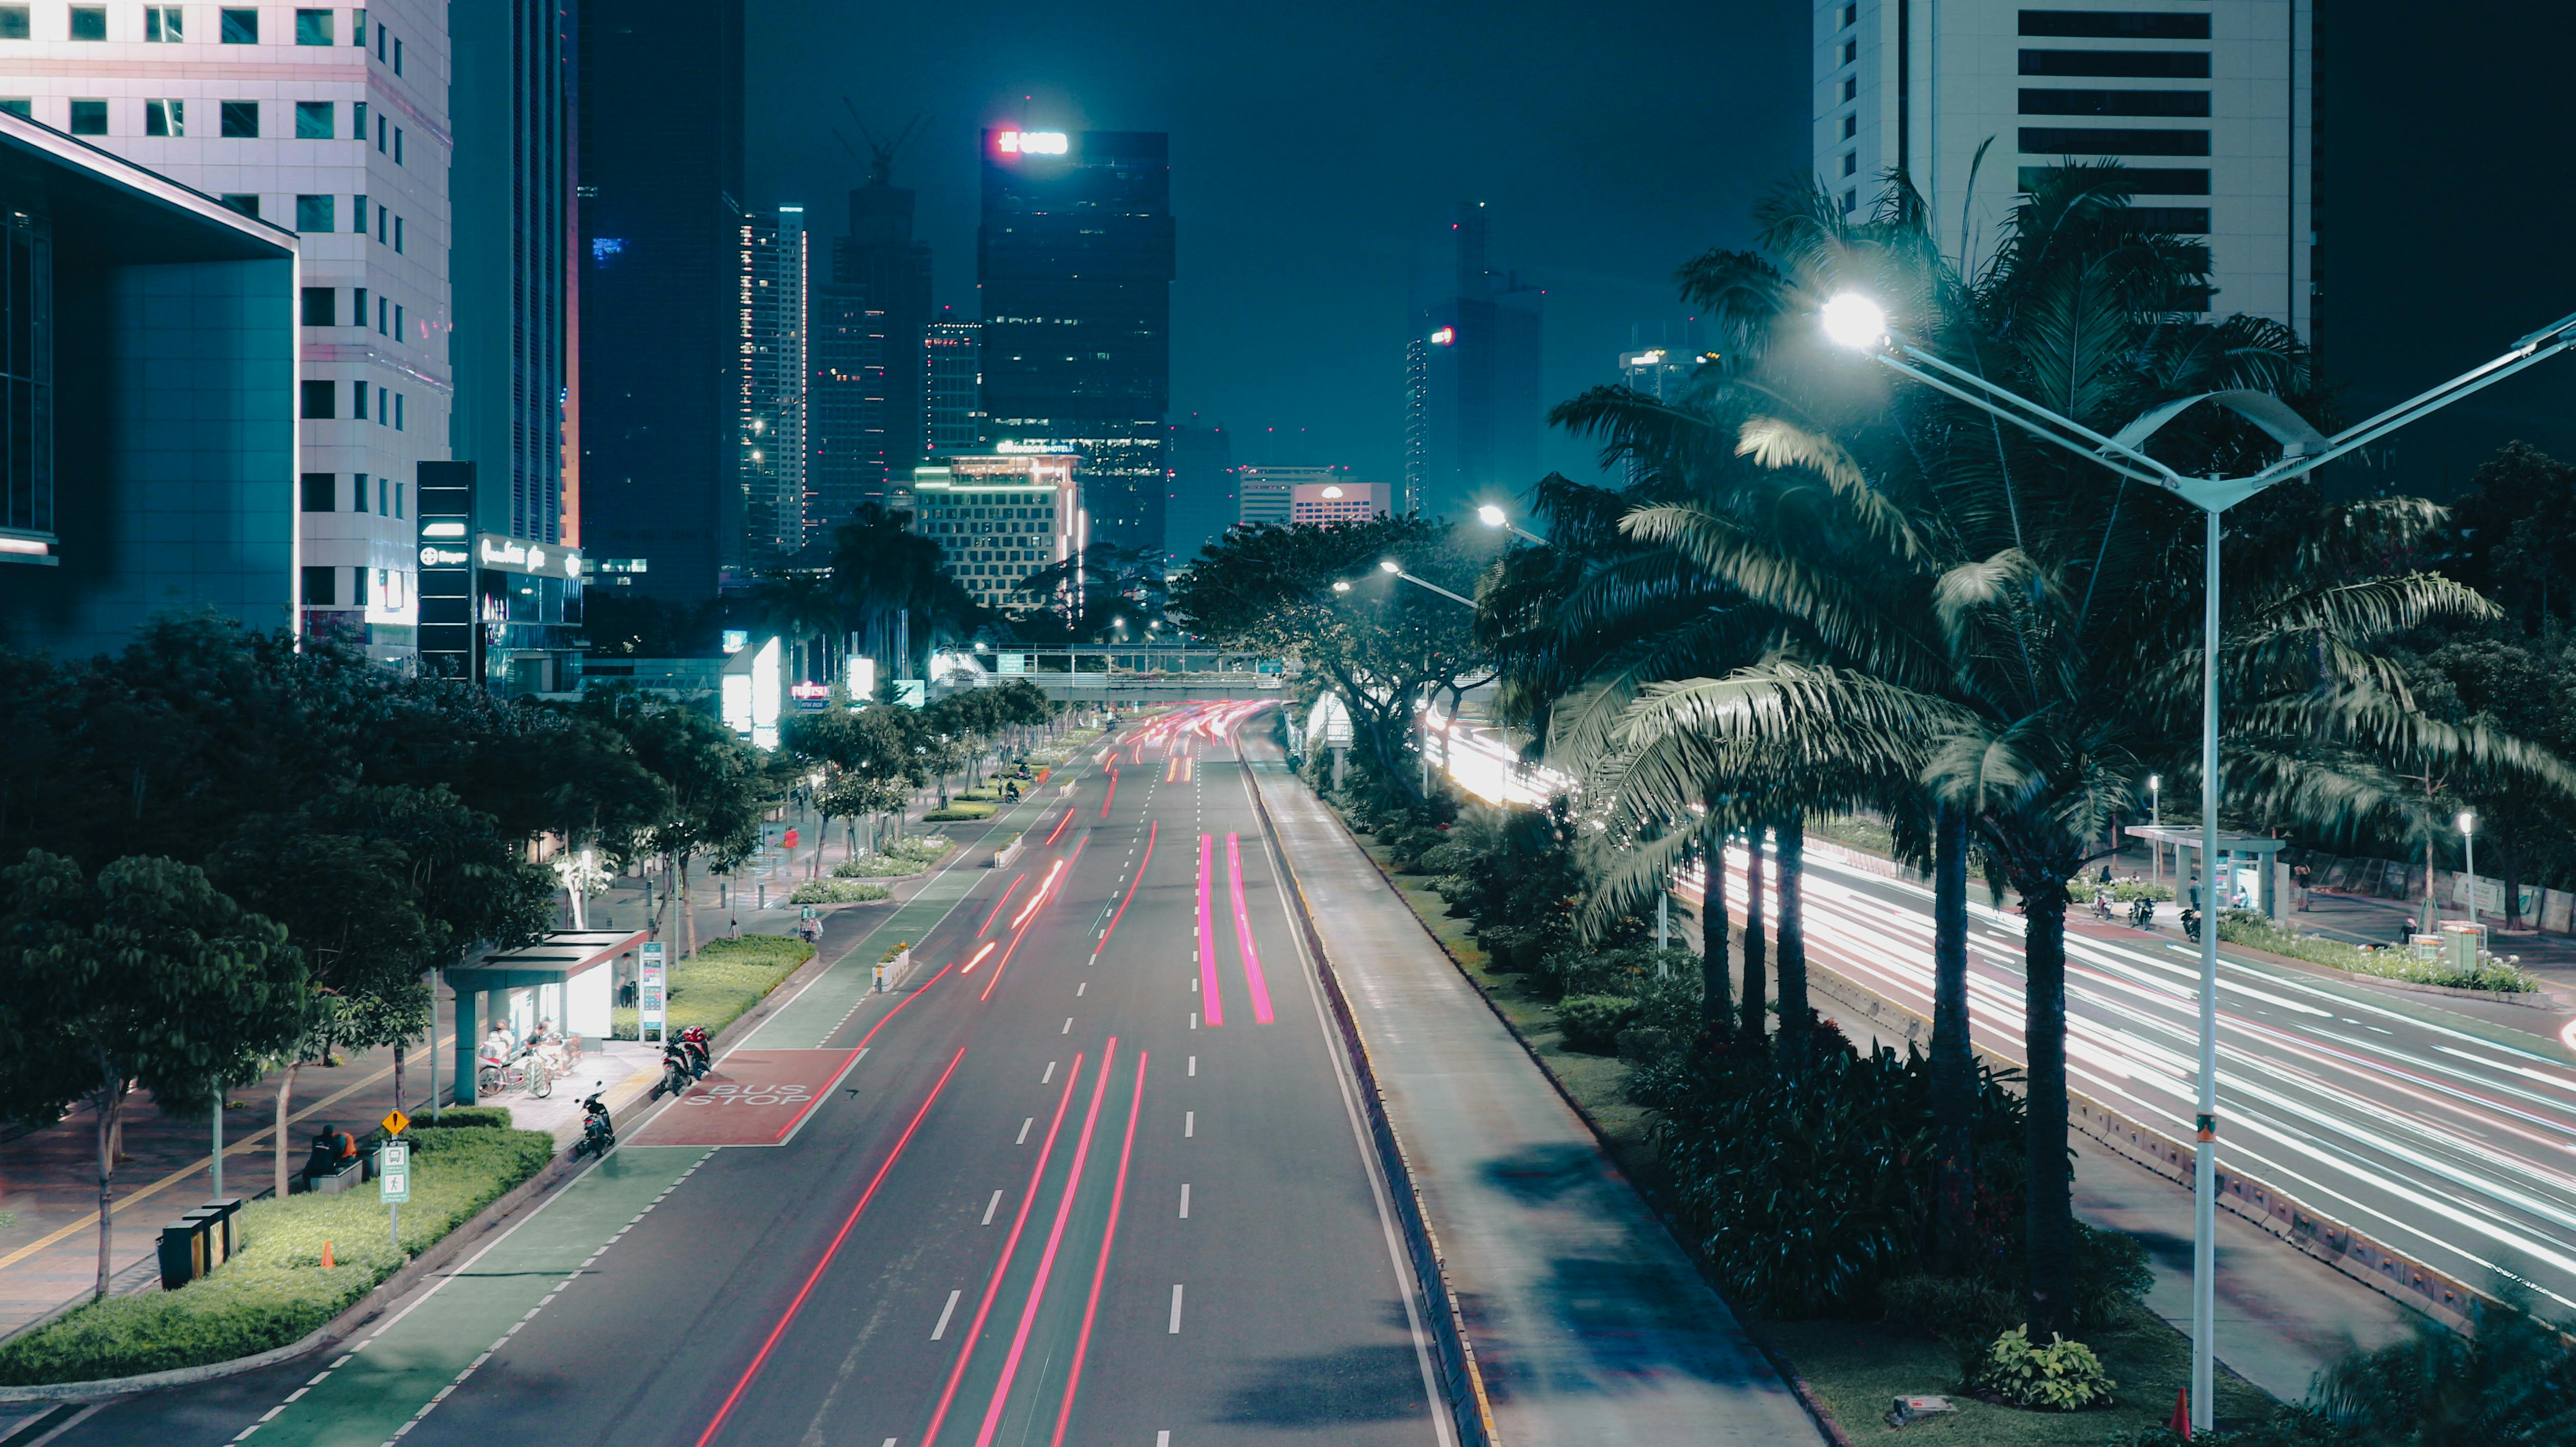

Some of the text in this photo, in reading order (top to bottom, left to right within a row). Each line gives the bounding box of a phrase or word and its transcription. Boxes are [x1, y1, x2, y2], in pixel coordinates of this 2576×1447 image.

[790, 679, 828, 699] FUJITSU
[707, 1084, 807, 1095] BUS
[683, 1095, 812, 1105] STOP
